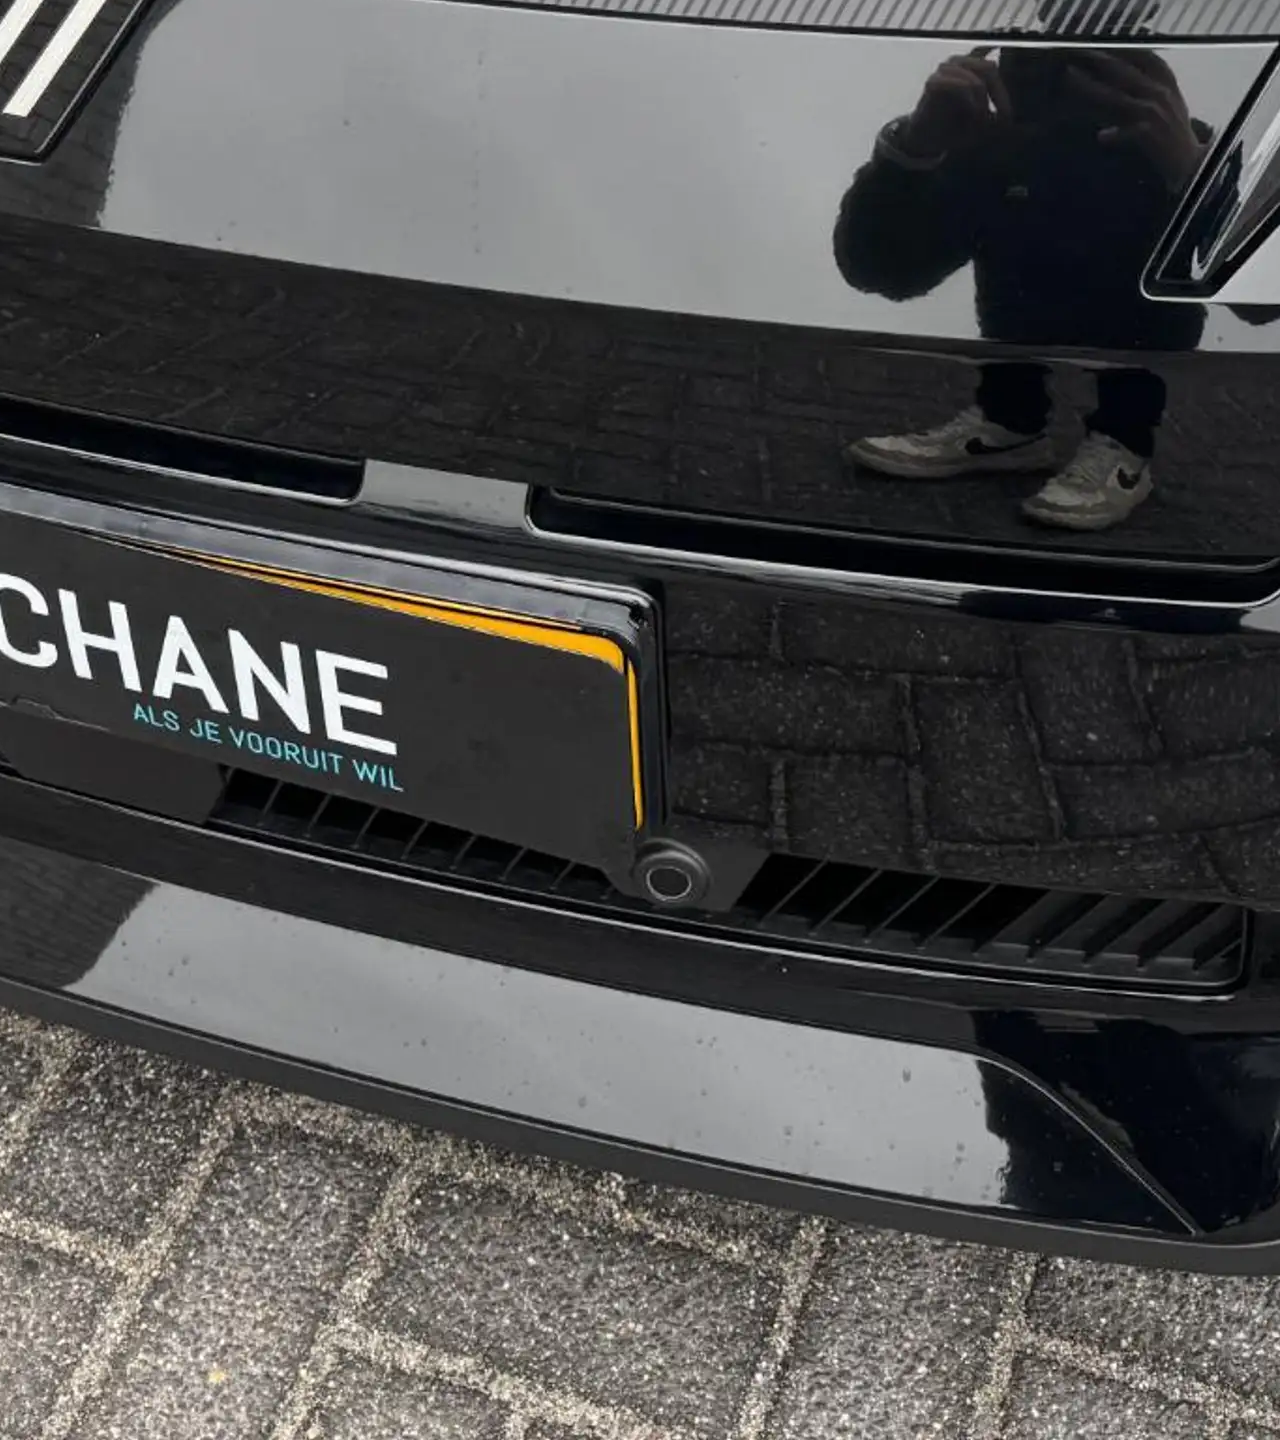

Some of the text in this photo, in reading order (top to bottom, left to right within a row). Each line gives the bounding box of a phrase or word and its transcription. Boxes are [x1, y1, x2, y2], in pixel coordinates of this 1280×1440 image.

[132, 703, 405, 793] ALS JE VOORUIT WIL
